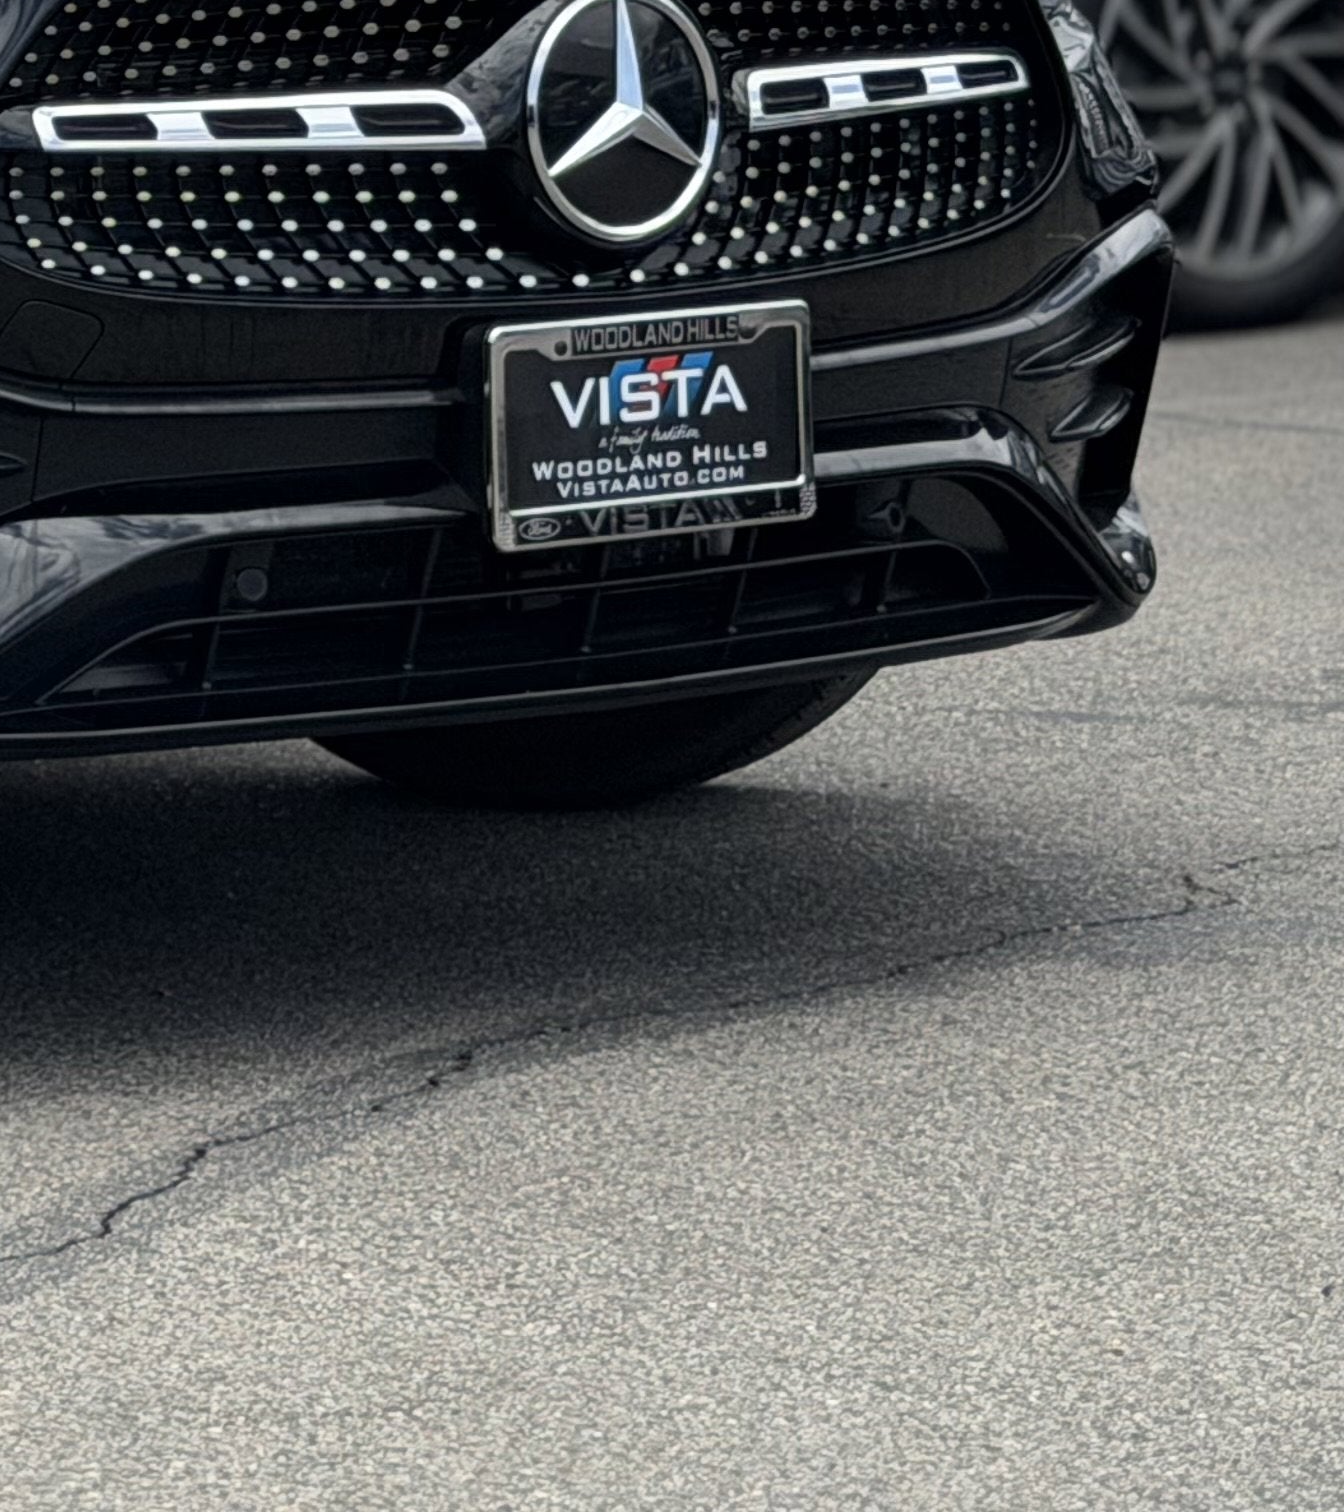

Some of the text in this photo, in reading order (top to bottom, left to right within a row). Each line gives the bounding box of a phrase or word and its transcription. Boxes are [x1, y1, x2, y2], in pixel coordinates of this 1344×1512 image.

[573, 315, 740, 354] WOODLAND HILLS
[549, 364, 749, 430] VISTA
[531, 440, 768, 482] WOODLAND HILLS
[577, 497, 705, 536] VISTA
